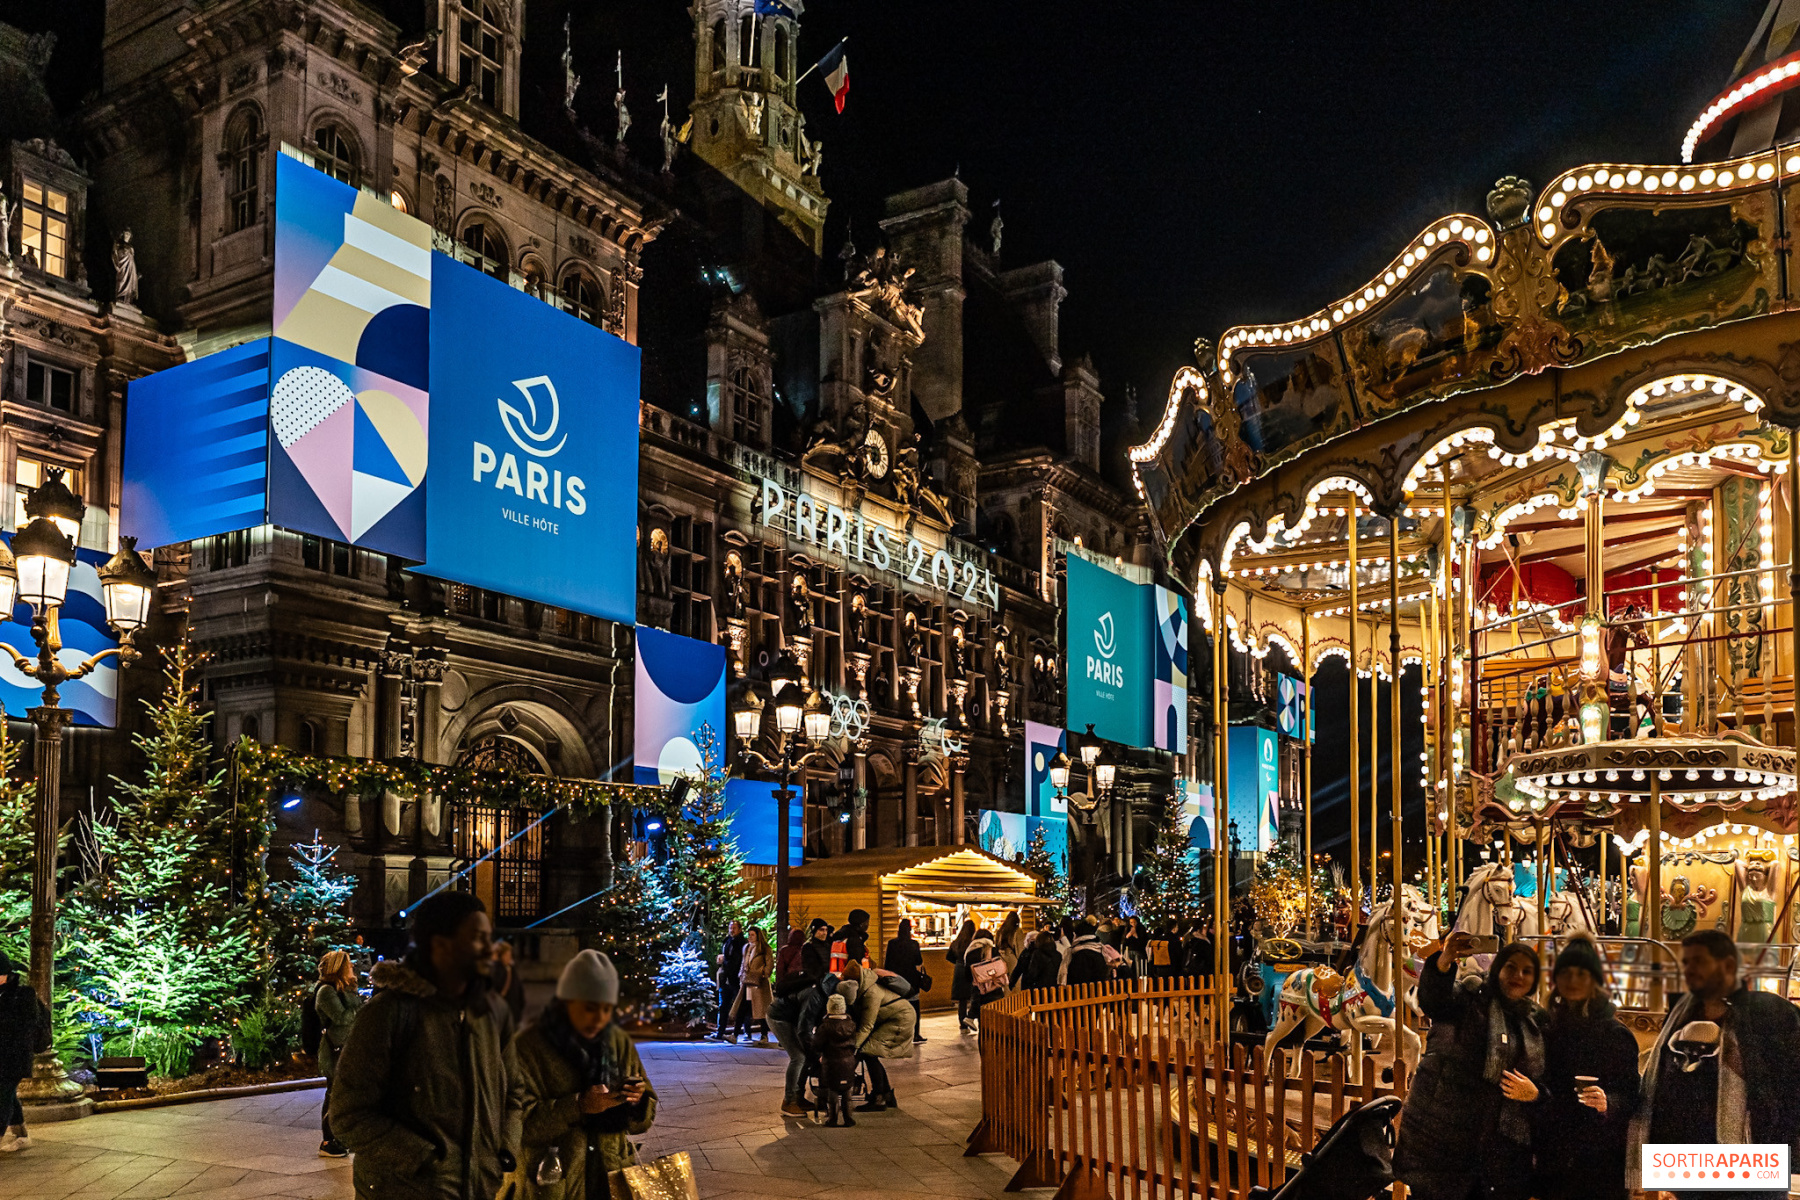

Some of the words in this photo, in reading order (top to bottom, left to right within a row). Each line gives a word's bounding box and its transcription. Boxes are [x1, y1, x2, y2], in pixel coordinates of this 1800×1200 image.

[473, 441, 586, 516] PARIS
[502, 507, 530, 527] VILLE
[532, 517, 559, 535] HÔTE
[763, 478, 890, 570] PARIS
[907, 538, 999, 612] 2024
[1086, 655, 1124, 689] PARIS
